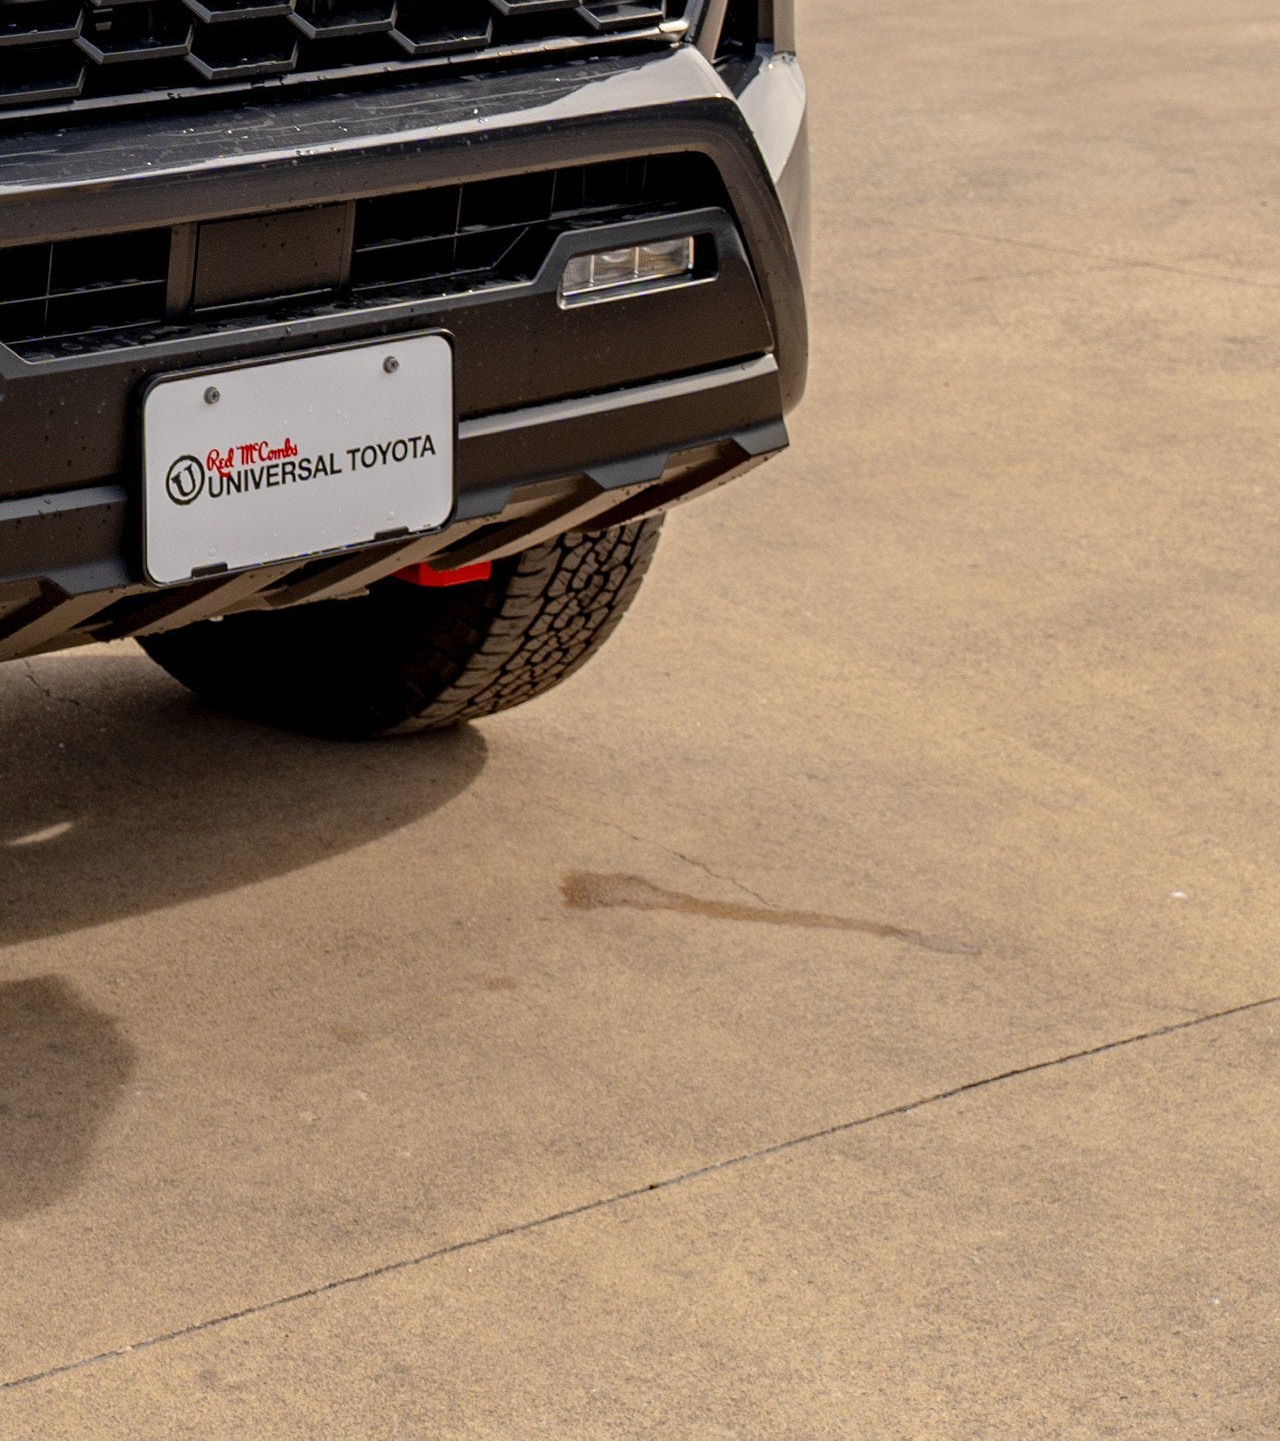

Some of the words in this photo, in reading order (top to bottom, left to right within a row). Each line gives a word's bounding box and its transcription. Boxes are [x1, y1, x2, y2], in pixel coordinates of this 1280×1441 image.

[206, 448, 234, 479] Red
[236, 436, 298, 467] McCombs
[208, 452, 342, 499] UNIVERSAL
[346, 434, 436, 471] TOYOTA
